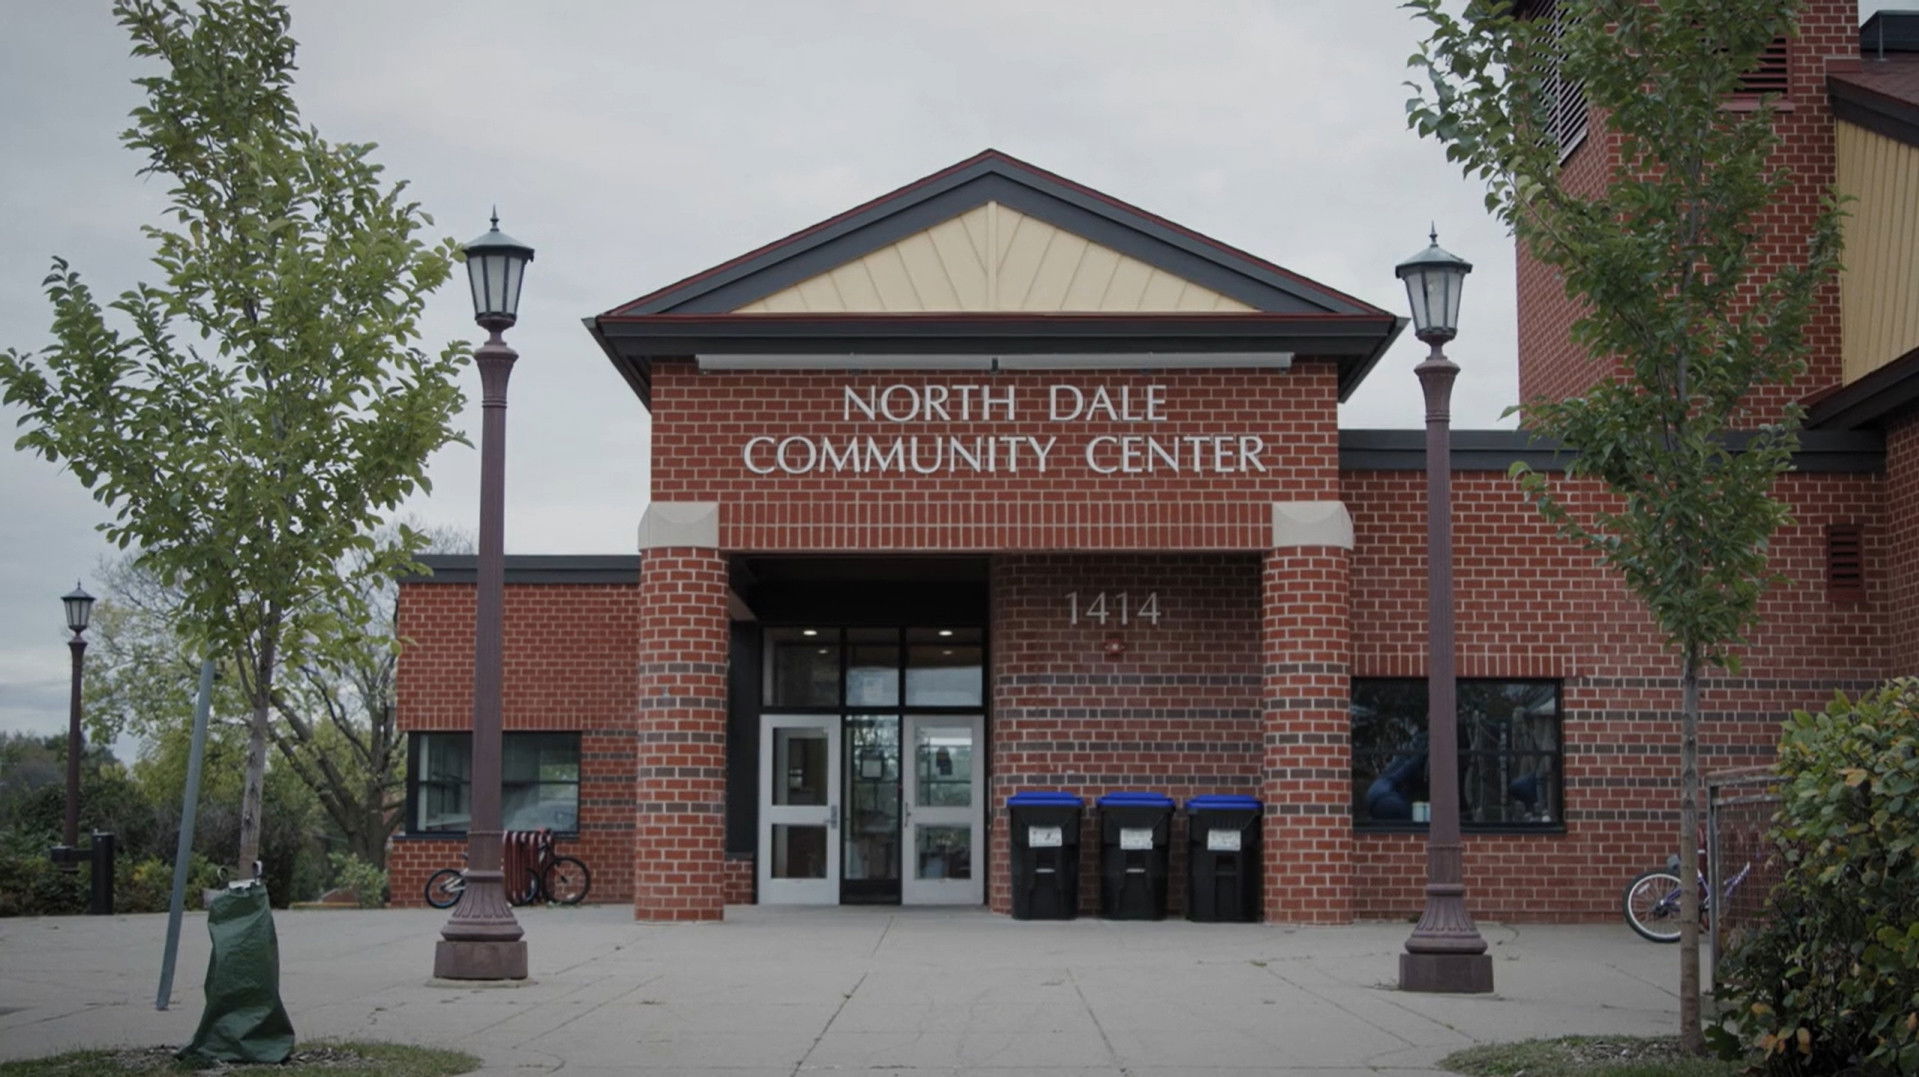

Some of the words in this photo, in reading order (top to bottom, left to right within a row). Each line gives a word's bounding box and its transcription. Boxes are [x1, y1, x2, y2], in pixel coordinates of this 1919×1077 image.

[843, 384, 1016, 422] NORTH
[1049, 385, 1168, 422] DALE
[743, 435, 1057, 474] COMMUNITY
[1085, 435, 1267, 474] CENTER
[1065, 591, 1162, 626] 1414
